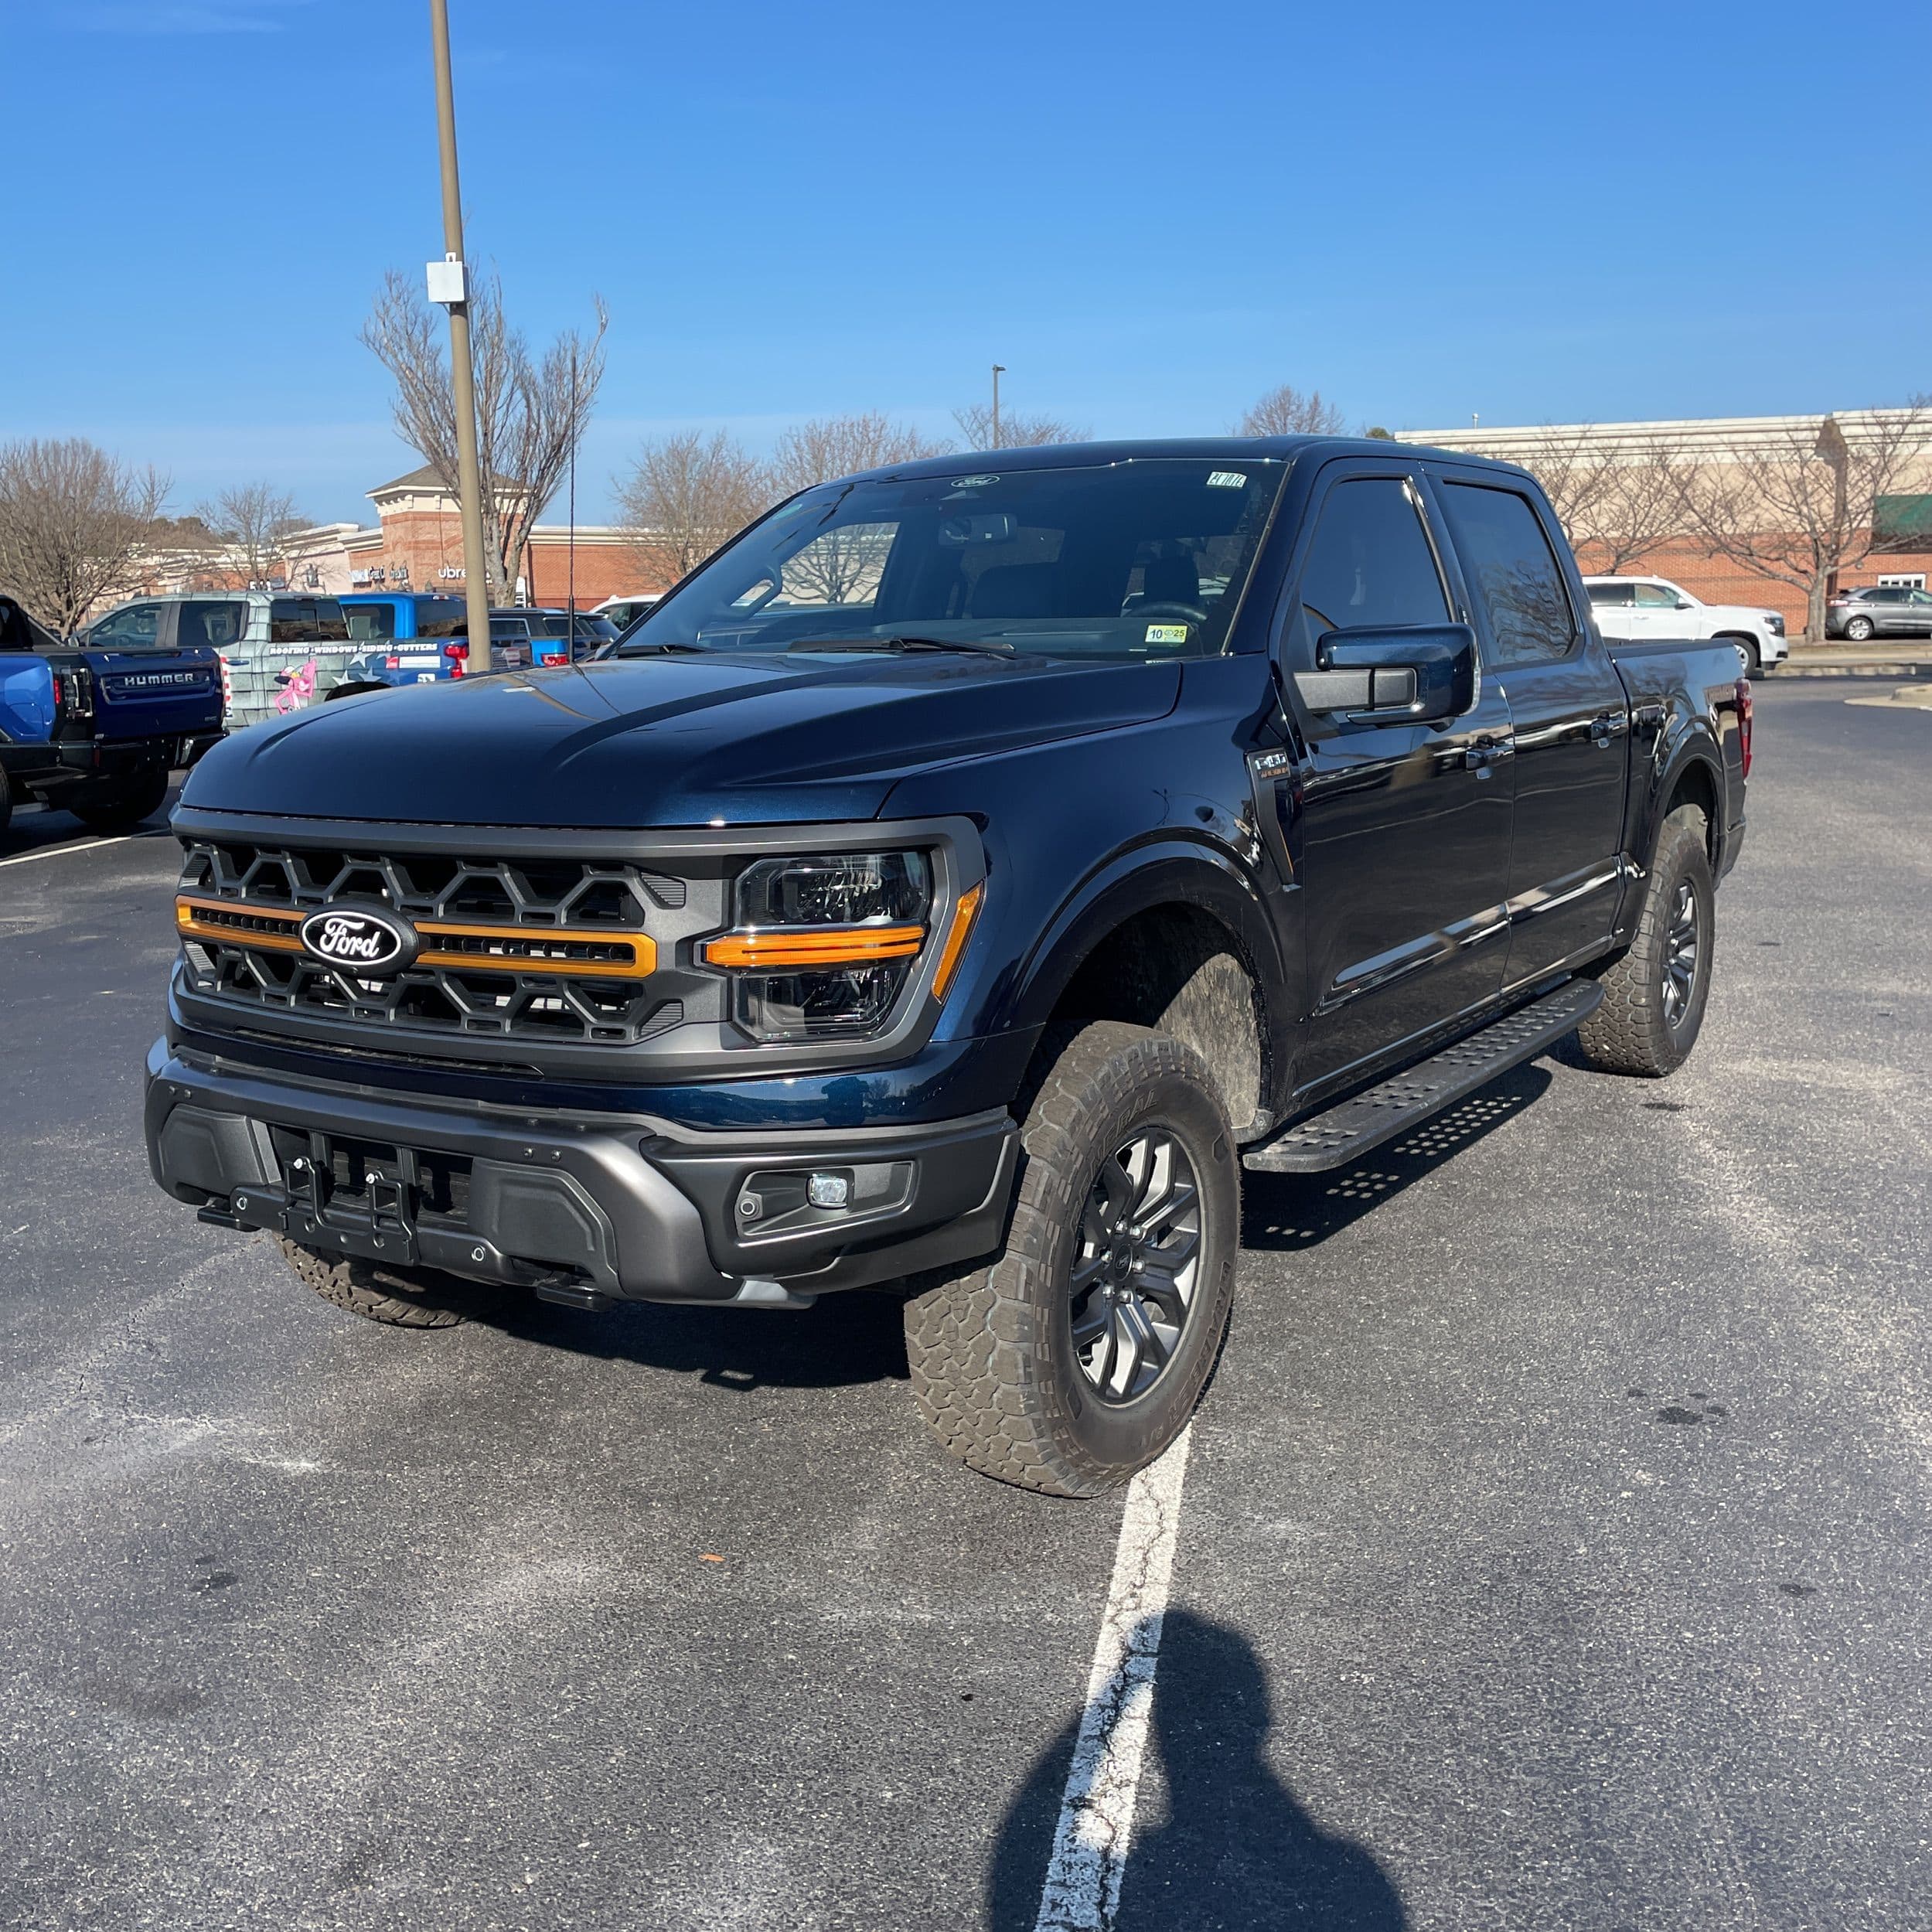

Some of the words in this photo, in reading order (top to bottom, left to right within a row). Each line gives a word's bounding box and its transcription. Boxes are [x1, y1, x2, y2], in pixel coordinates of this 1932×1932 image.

[1150, 629, 1163, 639] 10
[270, 646, 310, 655] ROOFING
[314, 645, 358, 654] WINDOWS
[362, 644, 393, 653] SIDING
[397, 643, 438, 652] GUTTERS
[124, 673, 193, 686] HUMMER
[319, 918, 380, 958] Ford
